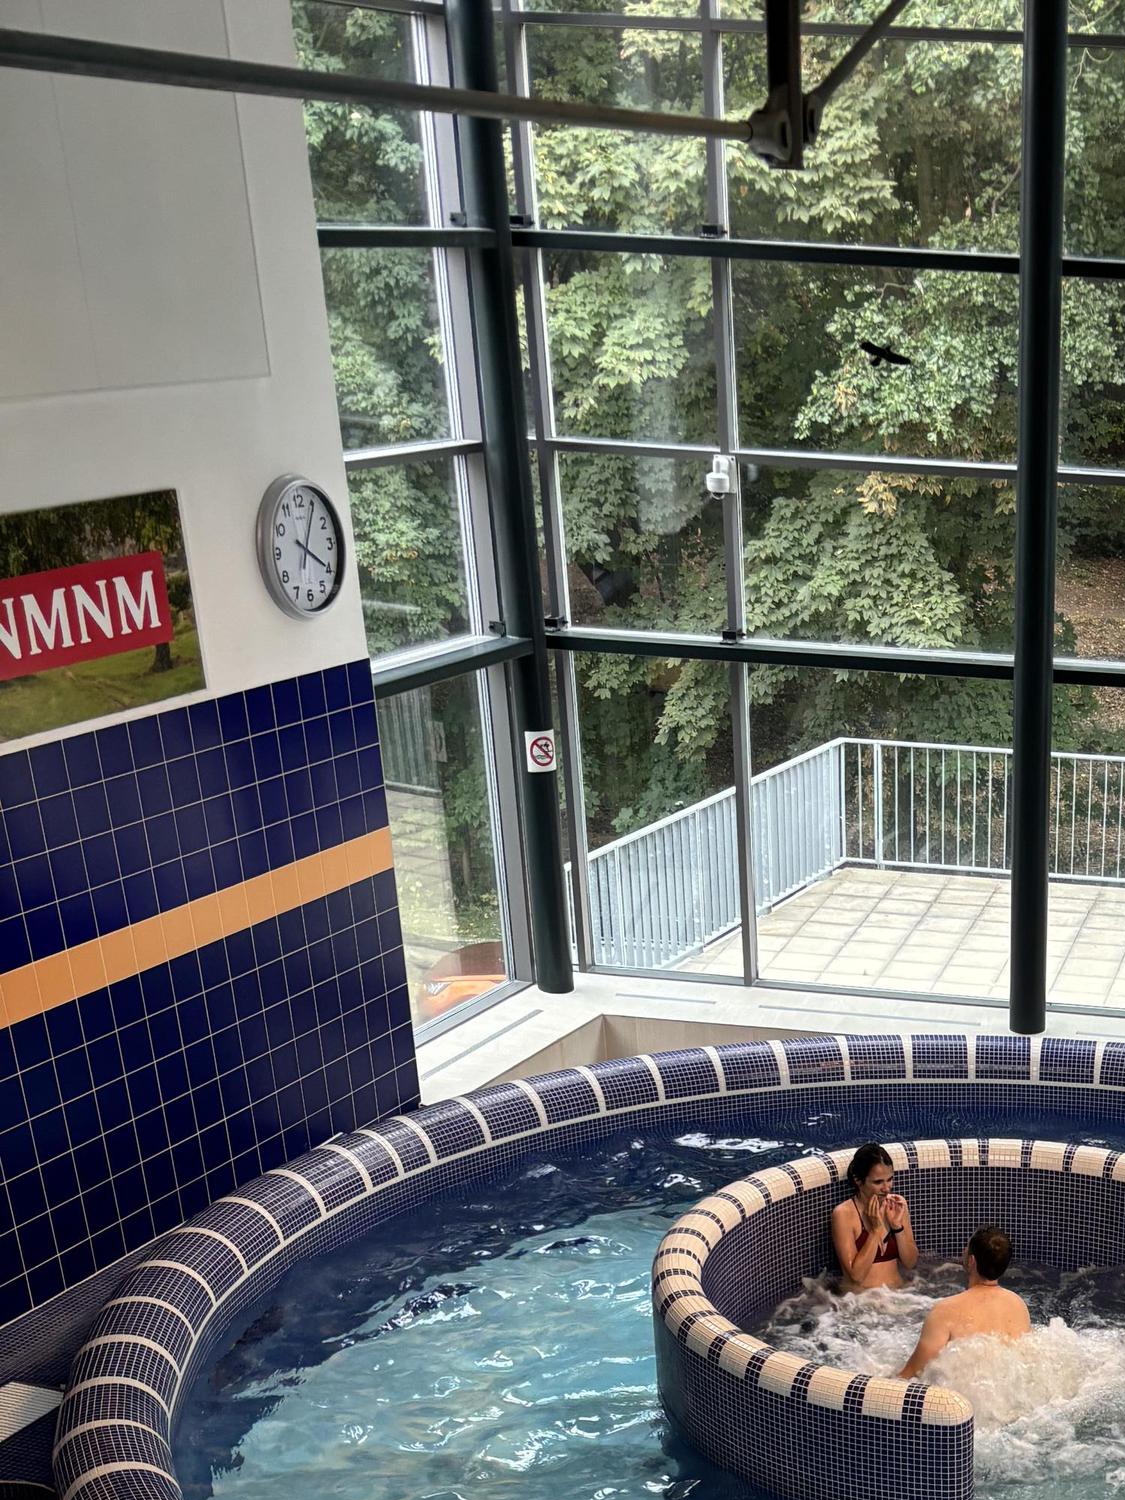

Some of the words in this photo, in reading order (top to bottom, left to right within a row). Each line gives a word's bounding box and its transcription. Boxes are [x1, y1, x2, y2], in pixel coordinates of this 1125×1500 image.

[293, 494, 304, 508] 12
[282, 503, 290, 518] 11
[275, 523, 286, 537] 10
[320, 516, 327, 530] 2
[326, 537, 334, 551] 3
[275, 547, 282, 560] 9
[325, 561, 332, 575] 4
[282, 570, 289, 584] 8
[293, 585, 300, 600] 7
[319, 580, 326, 594] 5
[307, 589, 314, 602] 6
